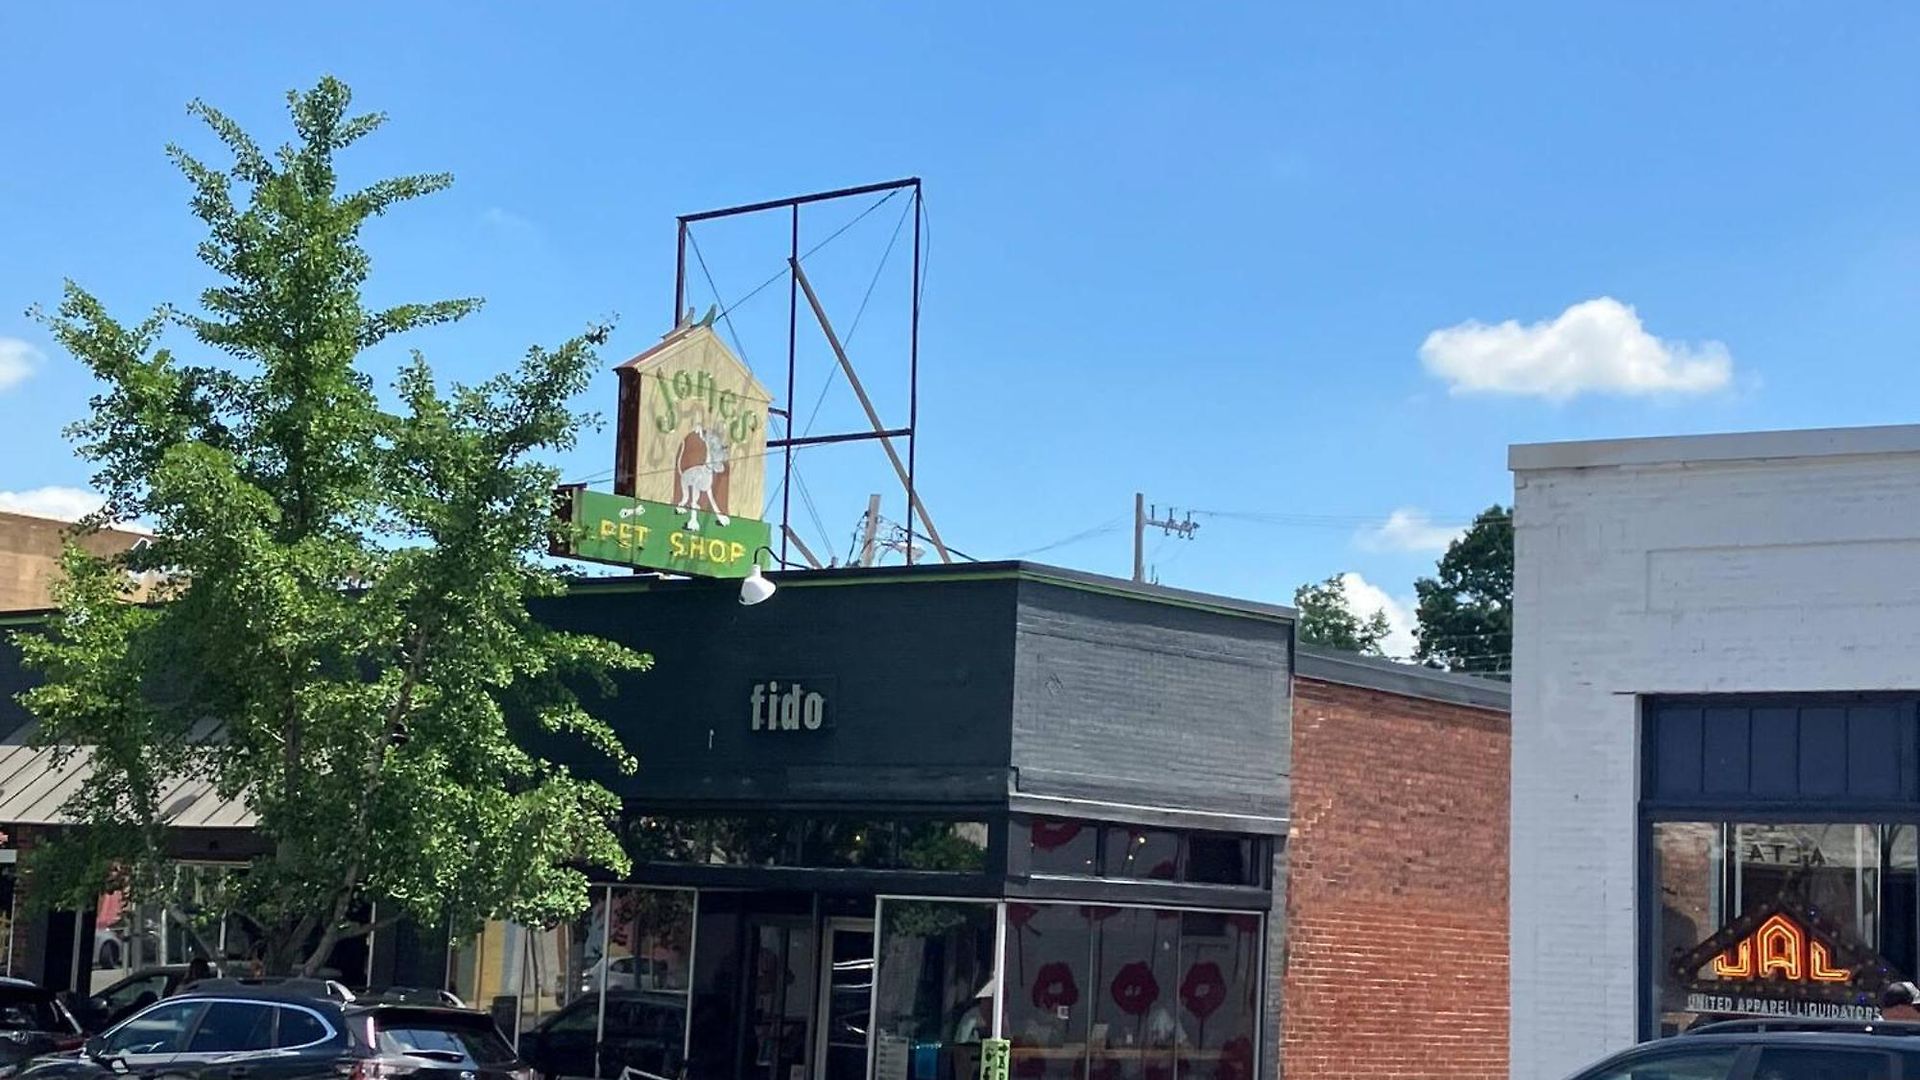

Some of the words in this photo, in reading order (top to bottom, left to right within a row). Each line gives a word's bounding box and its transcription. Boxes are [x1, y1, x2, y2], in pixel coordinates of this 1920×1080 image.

[600, 519, 651, 548] PET
[670, 532, 747, 564] SHOP
[751, 681, 824, 730] fido
[1687, 994, 1732, 1012] UNITED
[1737, 998, 1792, 1016] APPAREL
[1796, 1001, 1881, 1021] LIQUIDATORS
